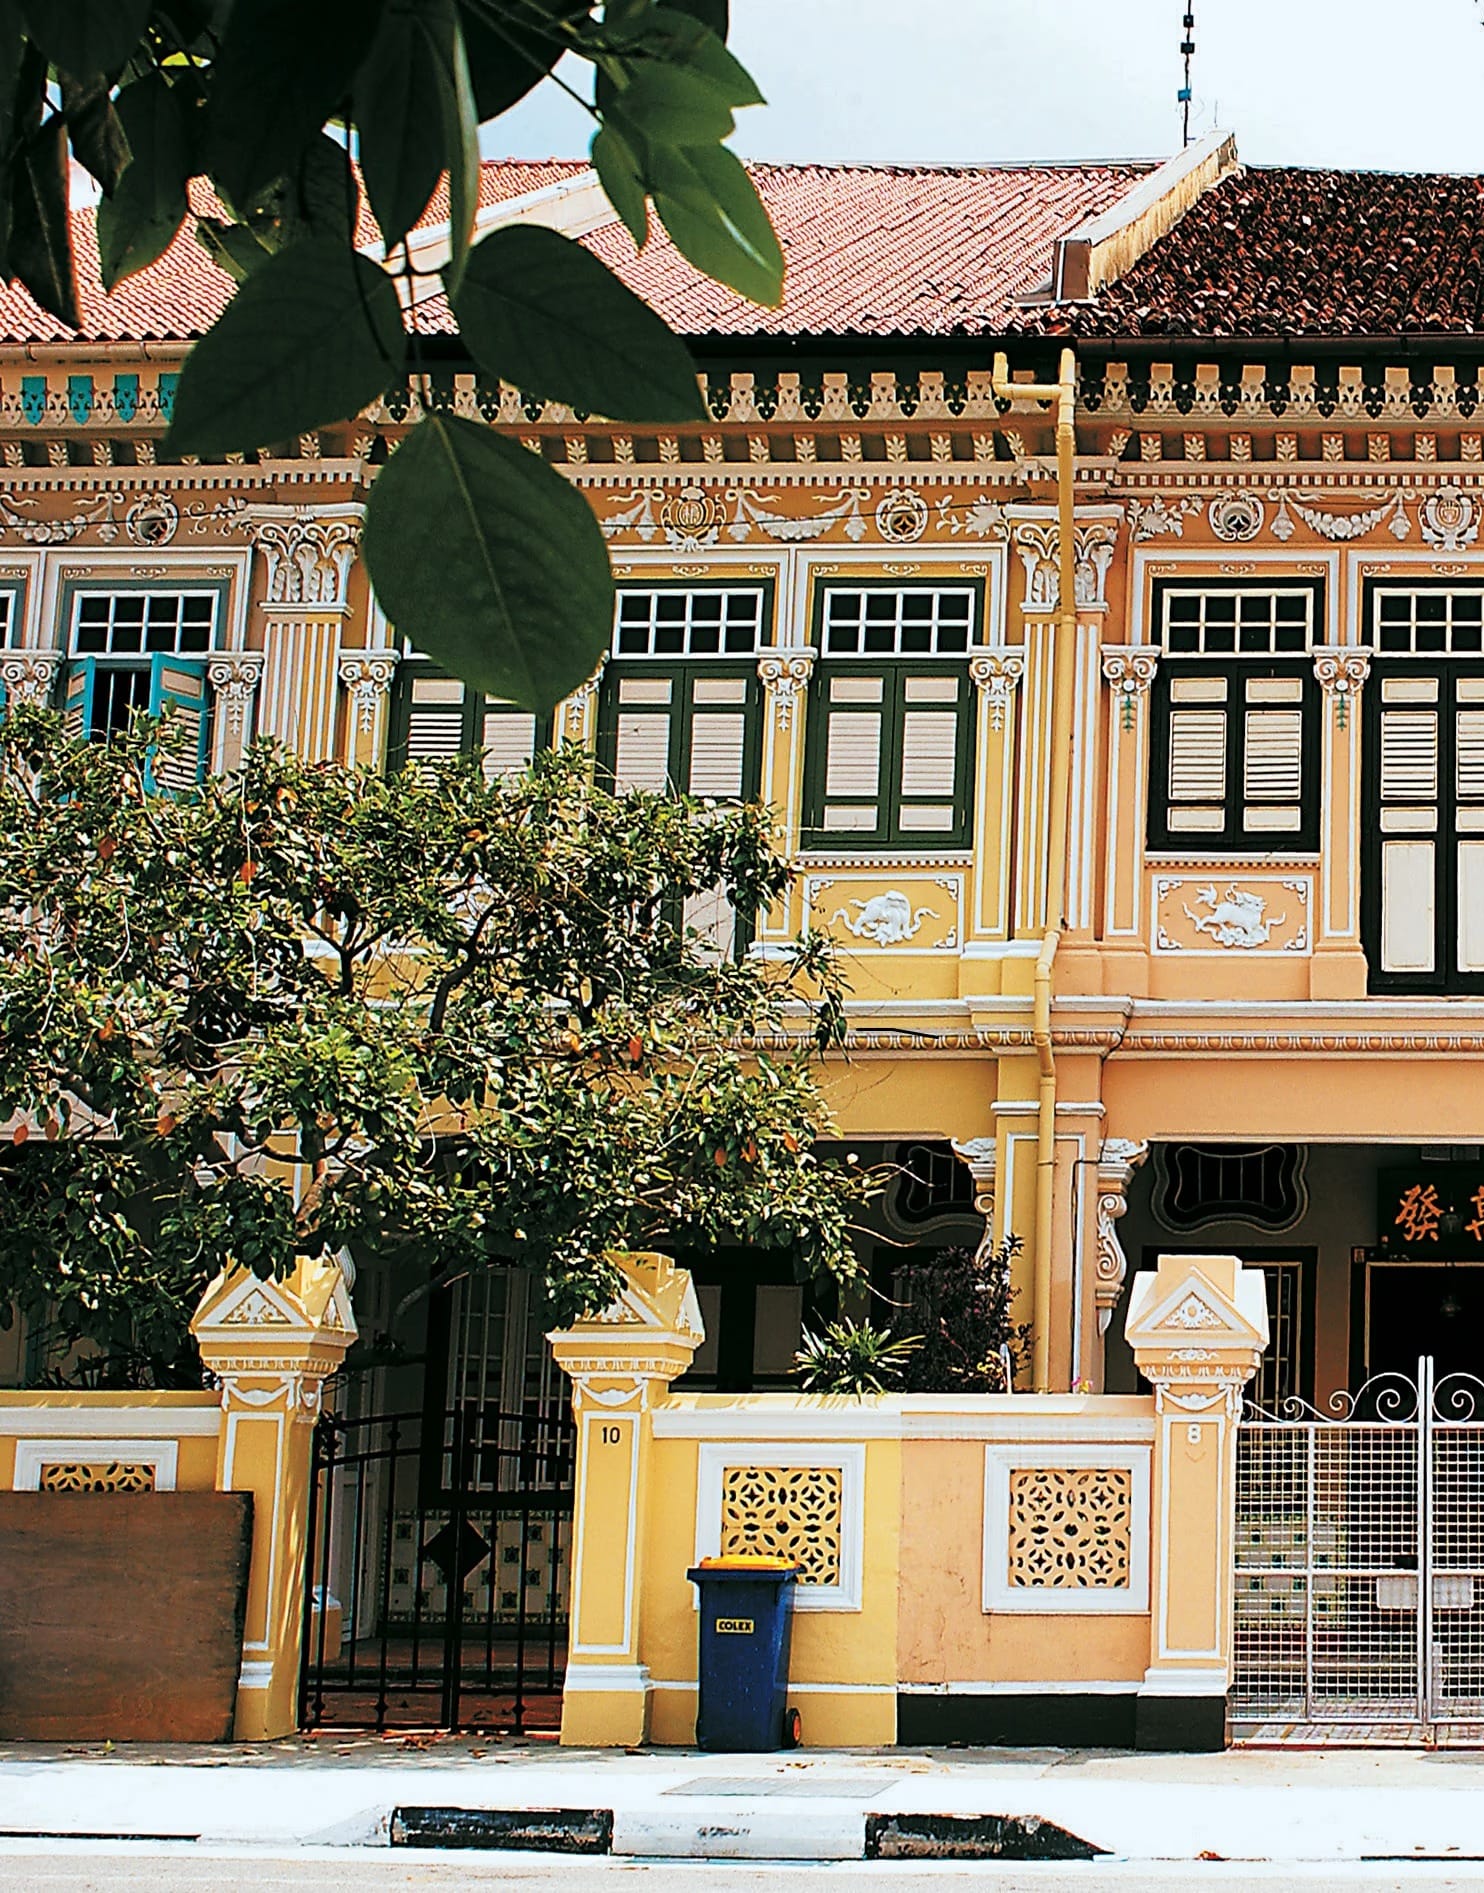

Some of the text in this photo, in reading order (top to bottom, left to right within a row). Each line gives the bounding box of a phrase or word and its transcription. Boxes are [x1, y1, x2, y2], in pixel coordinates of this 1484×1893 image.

[602, 1426, 621, 1444] 10
[1188, 1423, 1201, 1444] 8
[718, 1620, 752, 1631] COLEX
